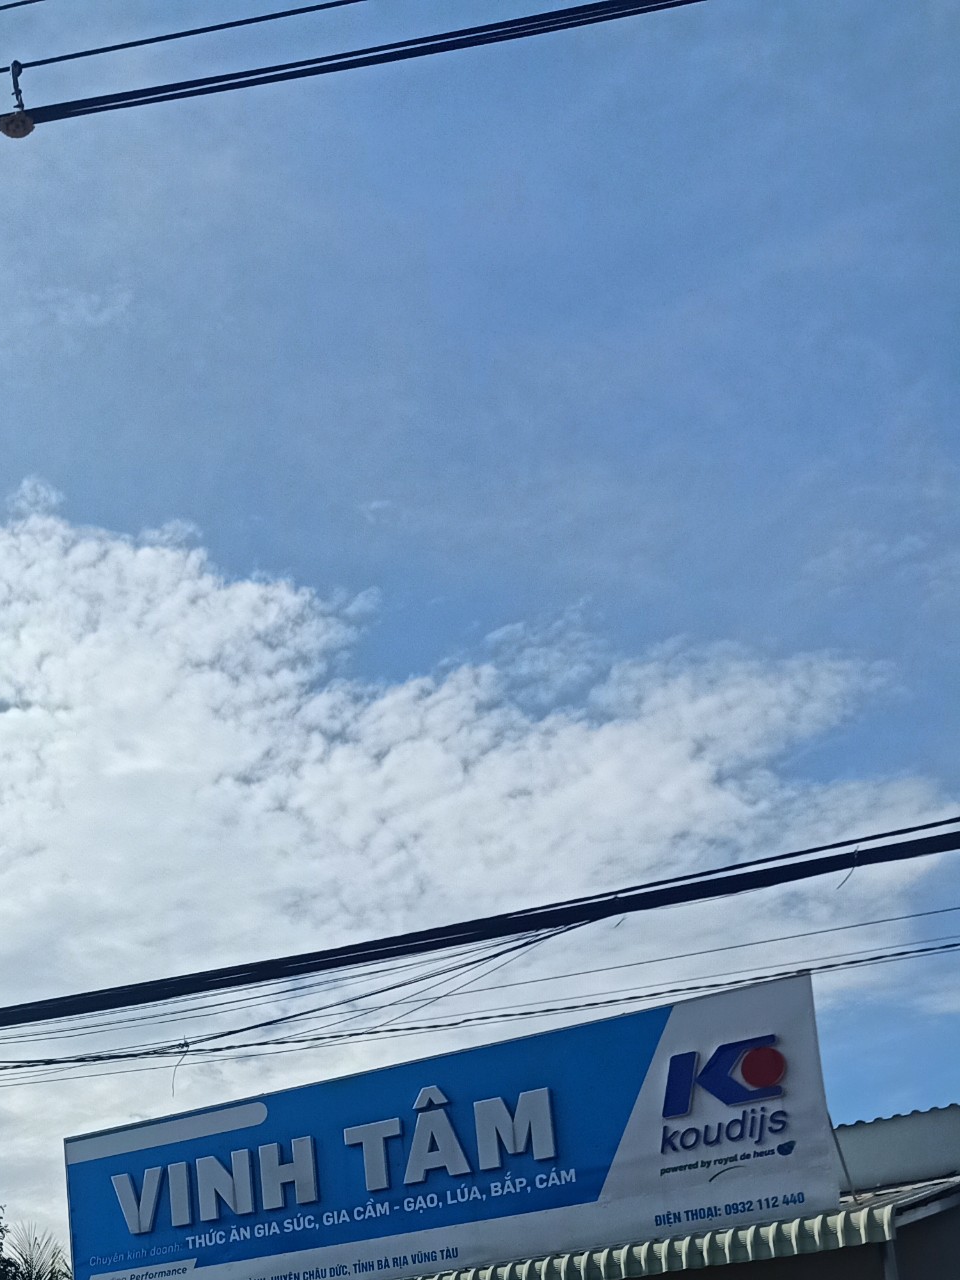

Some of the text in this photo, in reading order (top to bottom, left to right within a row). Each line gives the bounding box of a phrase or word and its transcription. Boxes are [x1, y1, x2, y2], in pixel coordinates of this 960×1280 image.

[660, 1106, 789, 1154] koudijs
[110, 1084, 557, 1235] VINH TÂM
[659, 1148, 776, 1176] powered by royal de heus
[185, 1228, 226, 1250] THỨC
[229, 1225, 251, 1243] ĂN
[254, 1221, 281, 1238] GIA
[283, 1213, 320, 1233] SÚC,
[322, 1209, 351, 1226] GIA
[353, 1198, 390, 1221] CẦM
[403, 1193, 443, 1214] GẠO,
[446, 1183, 487, 1205] LÚA,
[490, 1171, 531, 1197] BẮP,
[534, 1167, 577, 1189] CÁM
[654, 1191, 805, 1228] ĐIỆN THOẠI: 0932 112 440
[89, 1253, 125, 1267] Chuyên
[127, 1249, 147, 1261] kinh
[302, 1267, 327, 1280] CHÂU
